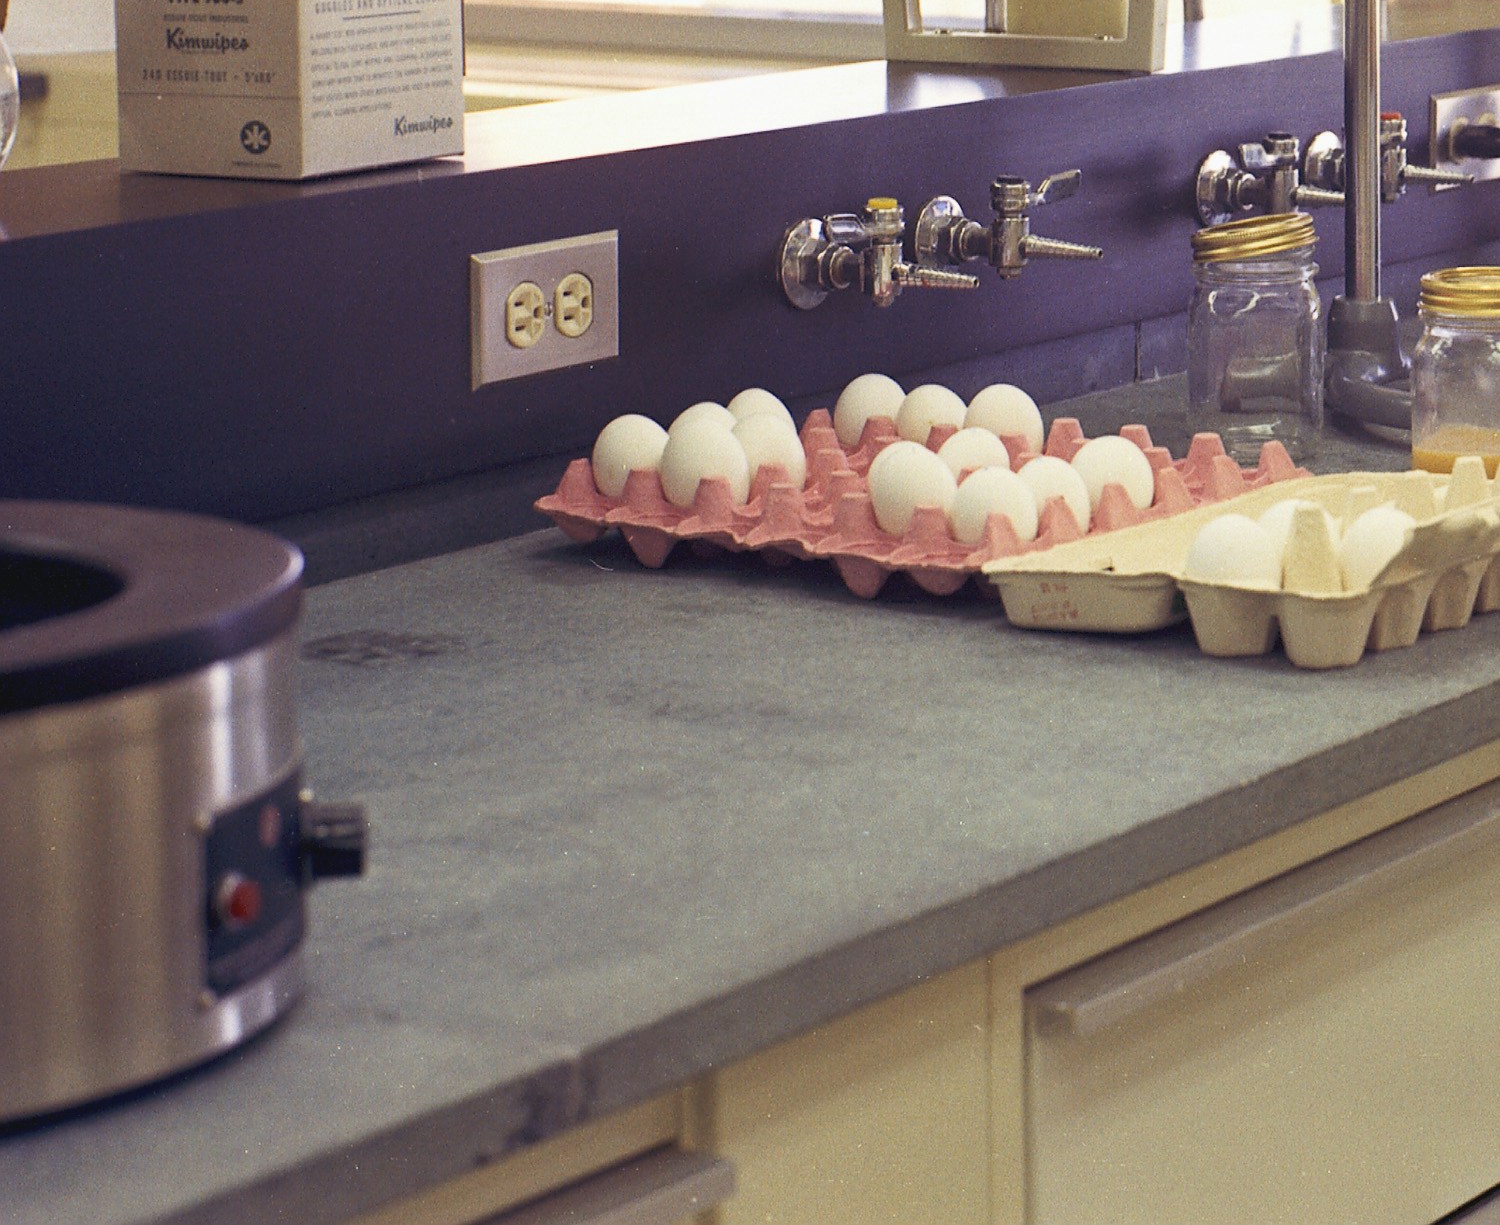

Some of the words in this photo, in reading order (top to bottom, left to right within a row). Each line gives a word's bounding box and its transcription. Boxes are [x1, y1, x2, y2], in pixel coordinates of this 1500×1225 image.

[315, 0, 354, 15] GOGGLES
[166, 27, 249, 54] Kimwipes
[394, 115, 453, 136] Kimwipes
